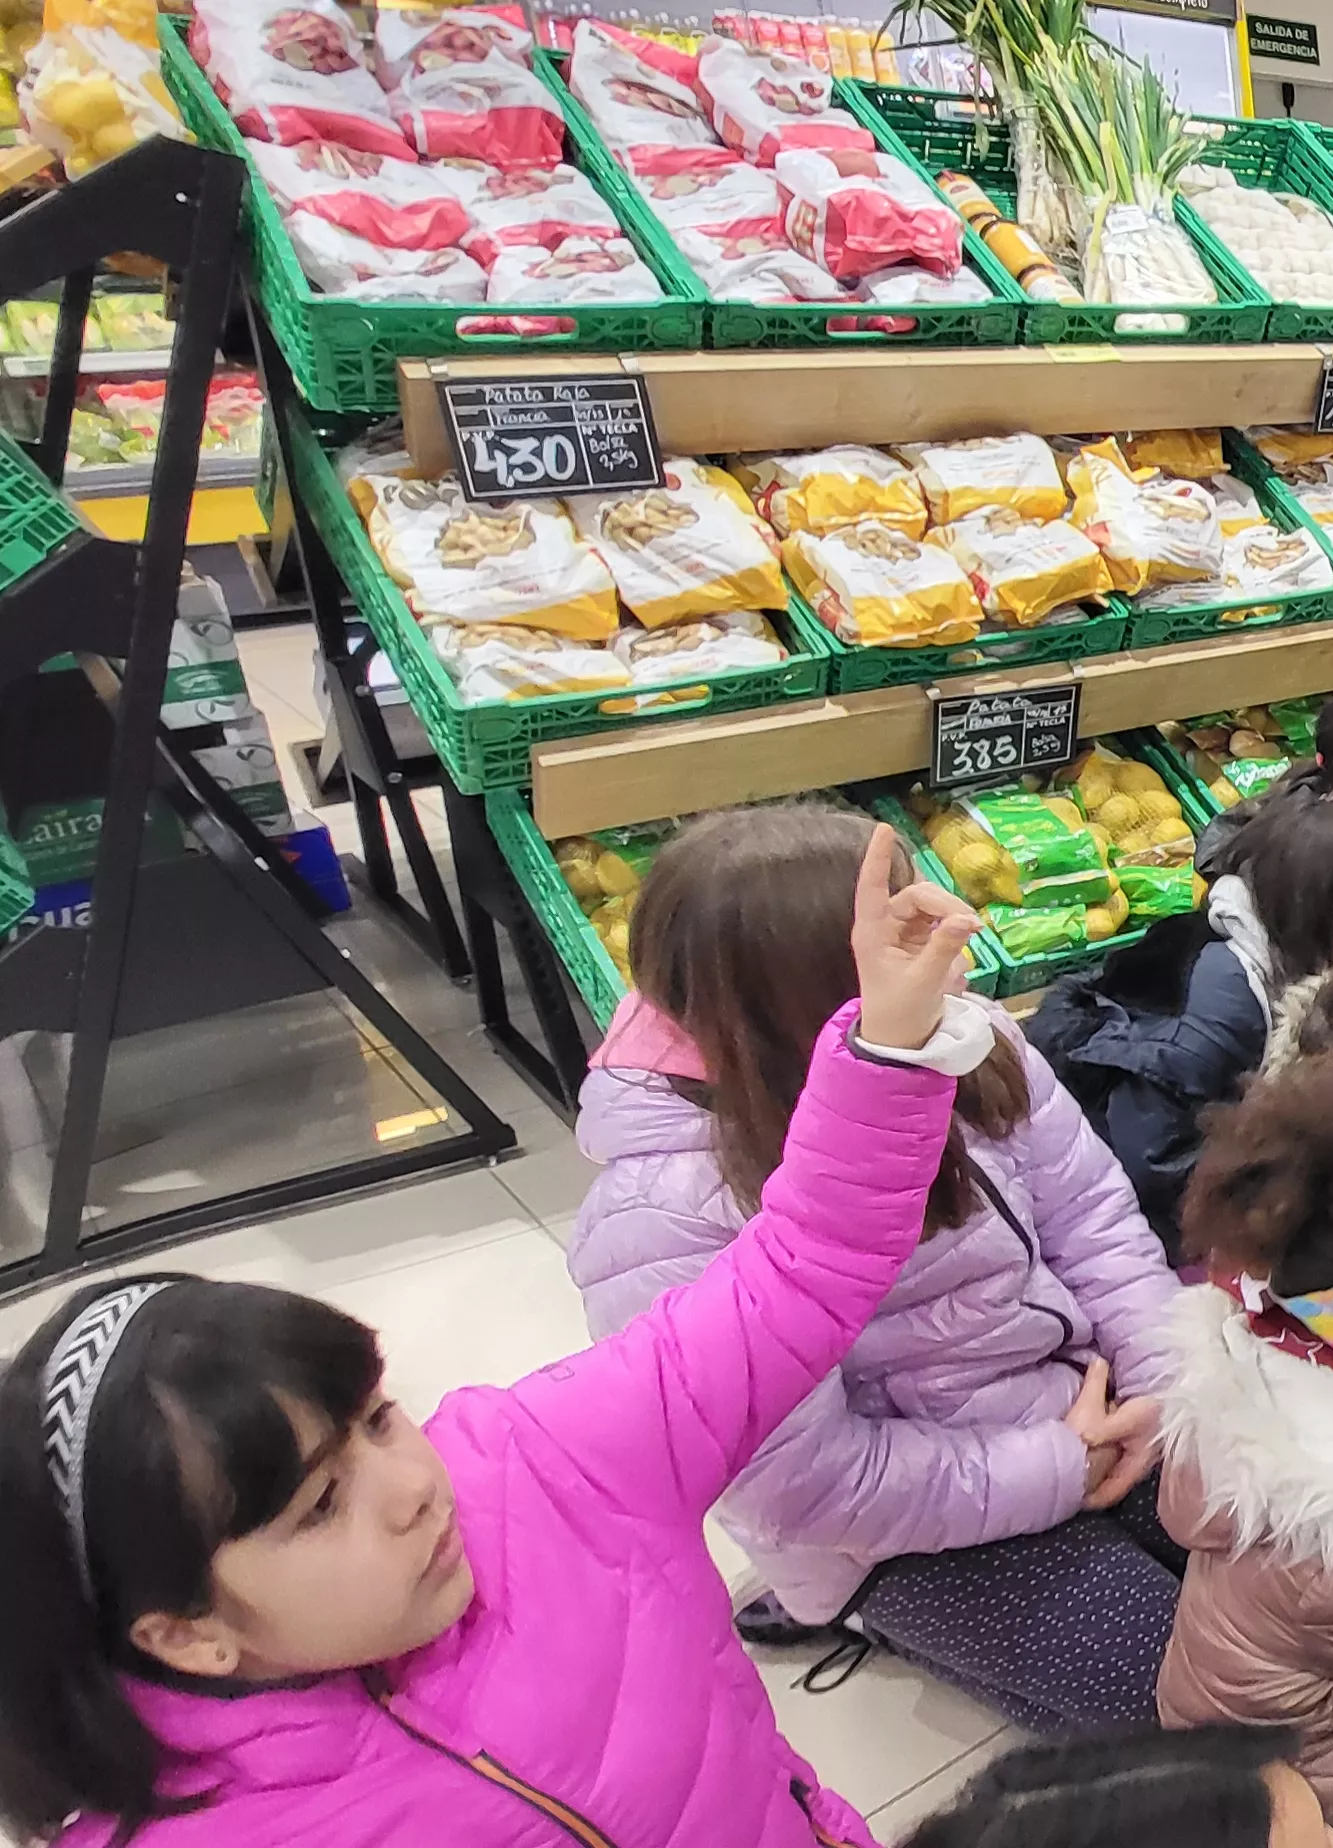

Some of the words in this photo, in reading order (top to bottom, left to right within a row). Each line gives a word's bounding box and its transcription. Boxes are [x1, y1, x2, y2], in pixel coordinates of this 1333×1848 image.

[1255, 22, 1293, 40] SALIDA
[1295, 28, 1310, 41] DE
[1250, 38, 1318, 59] EMERGENCIA
[967, 696, 1033, 716] Patata
[1039, 717, 1066, 727] TECLA
